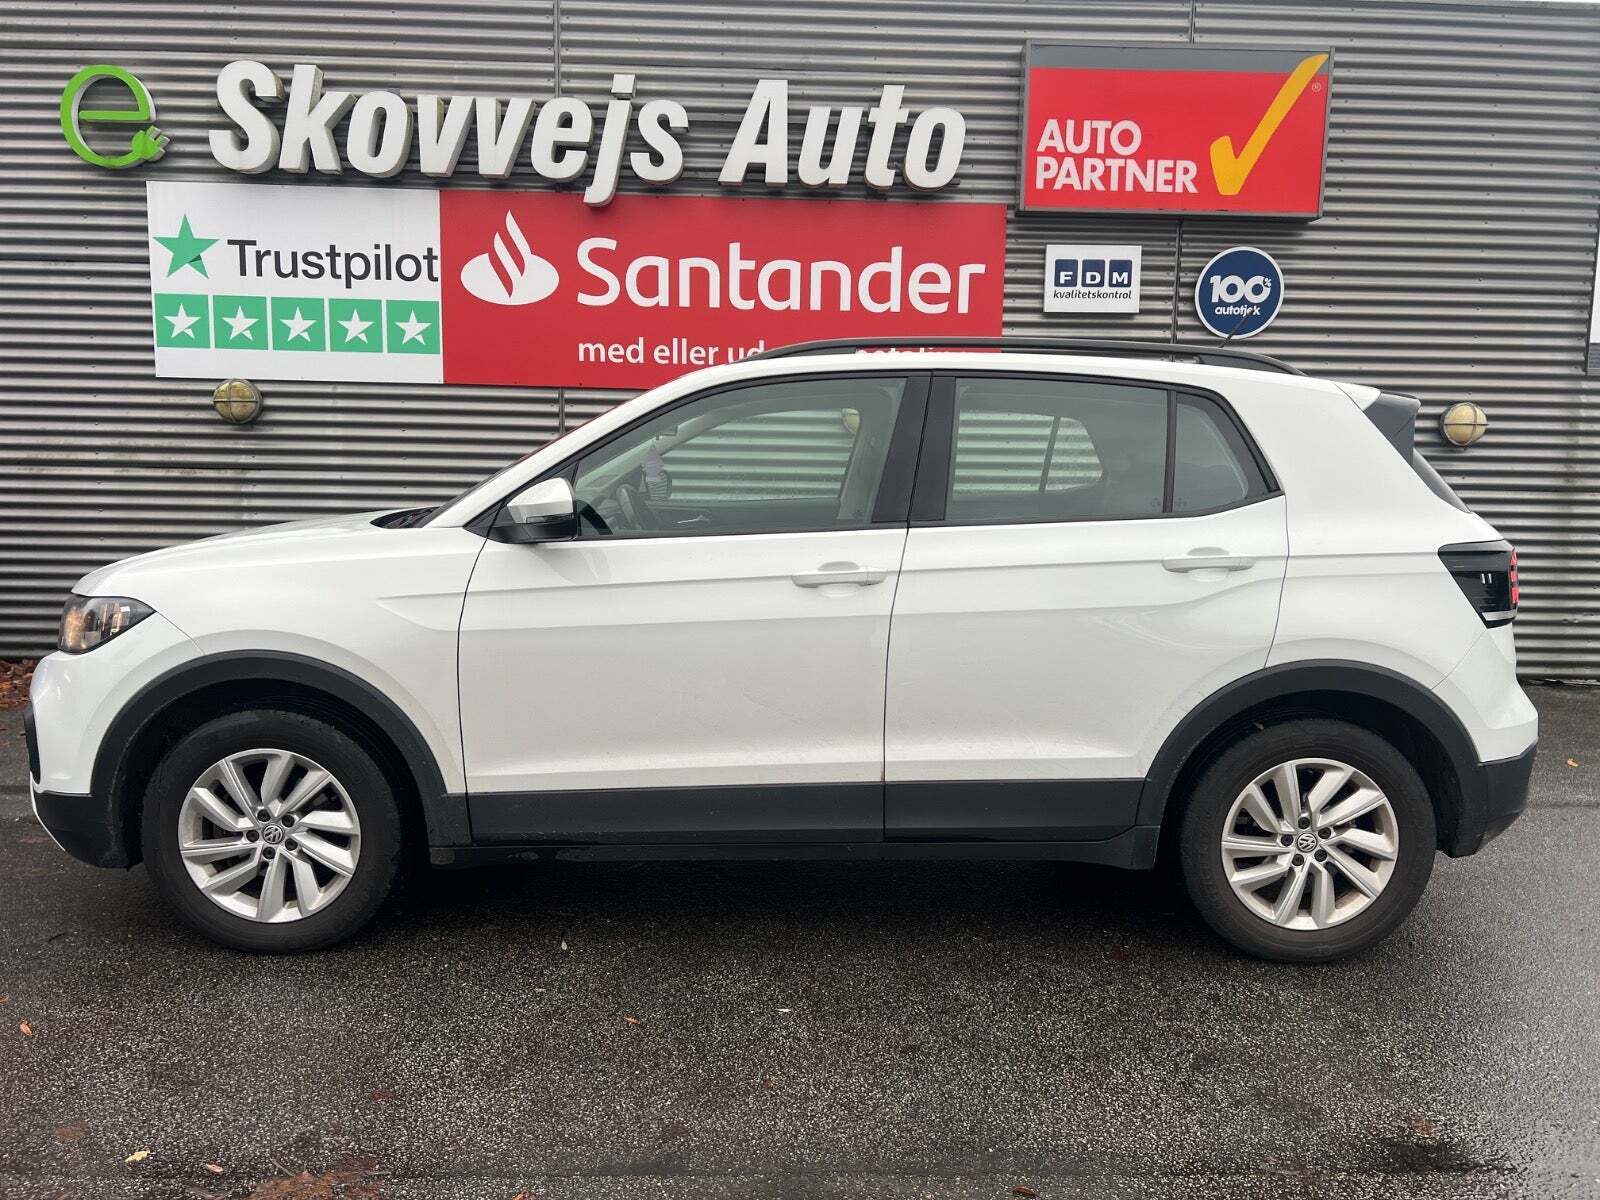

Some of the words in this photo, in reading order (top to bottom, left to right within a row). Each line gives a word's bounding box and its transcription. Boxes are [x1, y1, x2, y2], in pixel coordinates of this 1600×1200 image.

[208, 60, 689, 207] Skovvejs
[718, 79, 967, 190] Auto
[1036, 119, 1142, 156] AUTO
[1035, 156, 1198, 193] PARTNER
[227, 239, 439, 289] Trustpilot
[576, 236, 986, 314] Santander
[1059, 271, 1129, 285] FDM
[1053, 289, 1132, 300] kvalitetskontrol
[578, 336, 645, 363] med
[653, 337, 719, 365] eller
